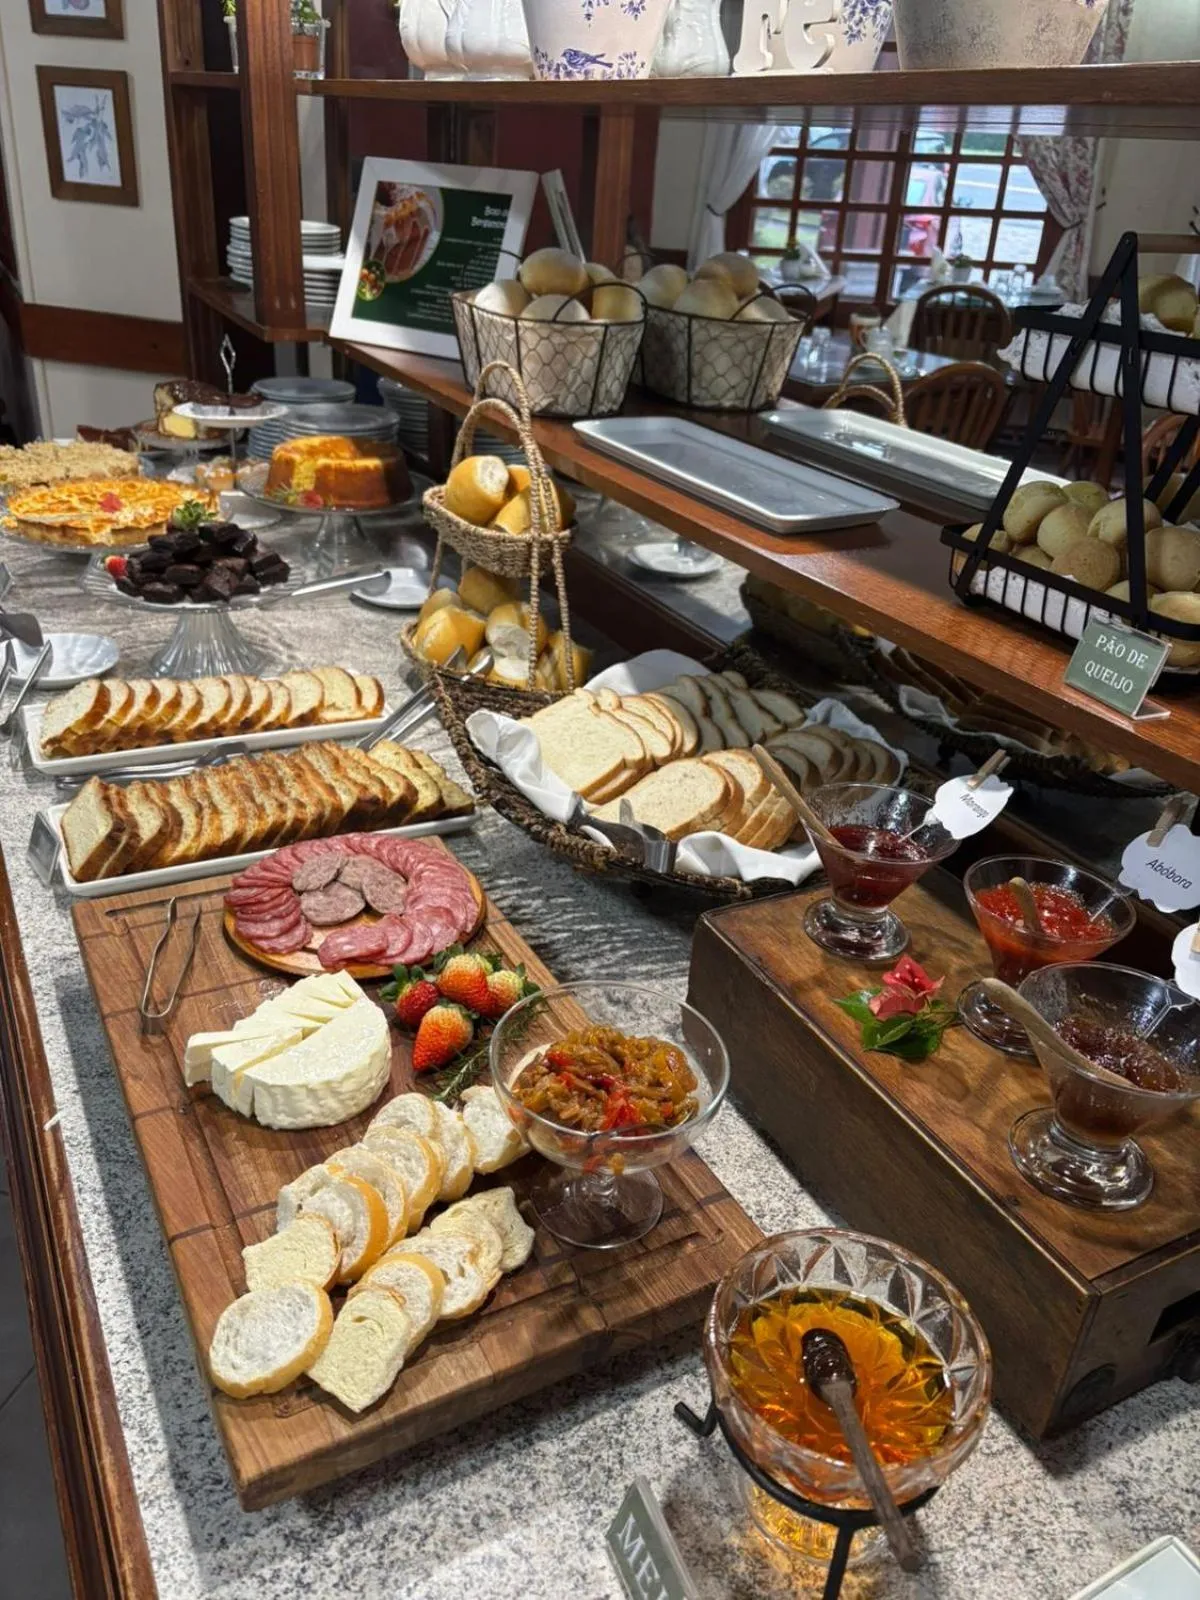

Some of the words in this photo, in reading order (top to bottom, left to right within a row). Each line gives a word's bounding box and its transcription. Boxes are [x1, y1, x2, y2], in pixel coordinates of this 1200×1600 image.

[1095, 634, 1126, 658] PÃO
[1126, 649, 1149, 669] DE
[1084, 660, 1134, 694] QUEIJO
[1145, 859, 1193, 889] Abóbora
